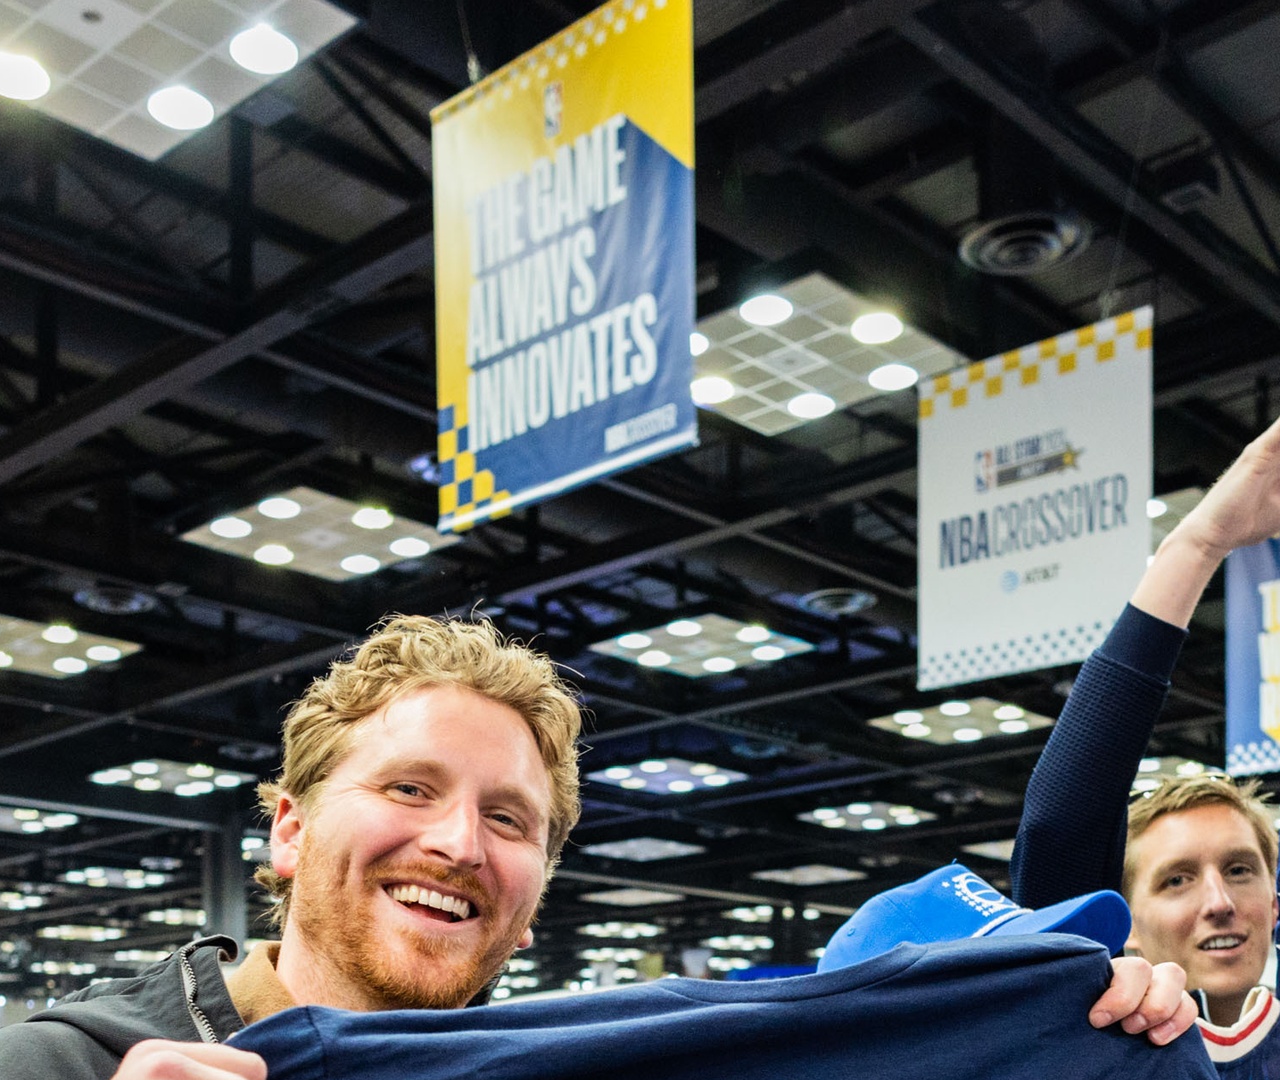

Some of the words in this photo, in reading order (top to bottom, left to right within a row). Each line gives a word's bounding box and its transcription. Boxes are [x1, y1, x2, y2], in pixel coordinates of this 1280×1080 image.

[467, 171, 525, 276] THE
[529, 112, 627, 242] GAME
[467, 226, 596, 368] ALWAYS
[467, 292, 658, 454] INNOVATES
